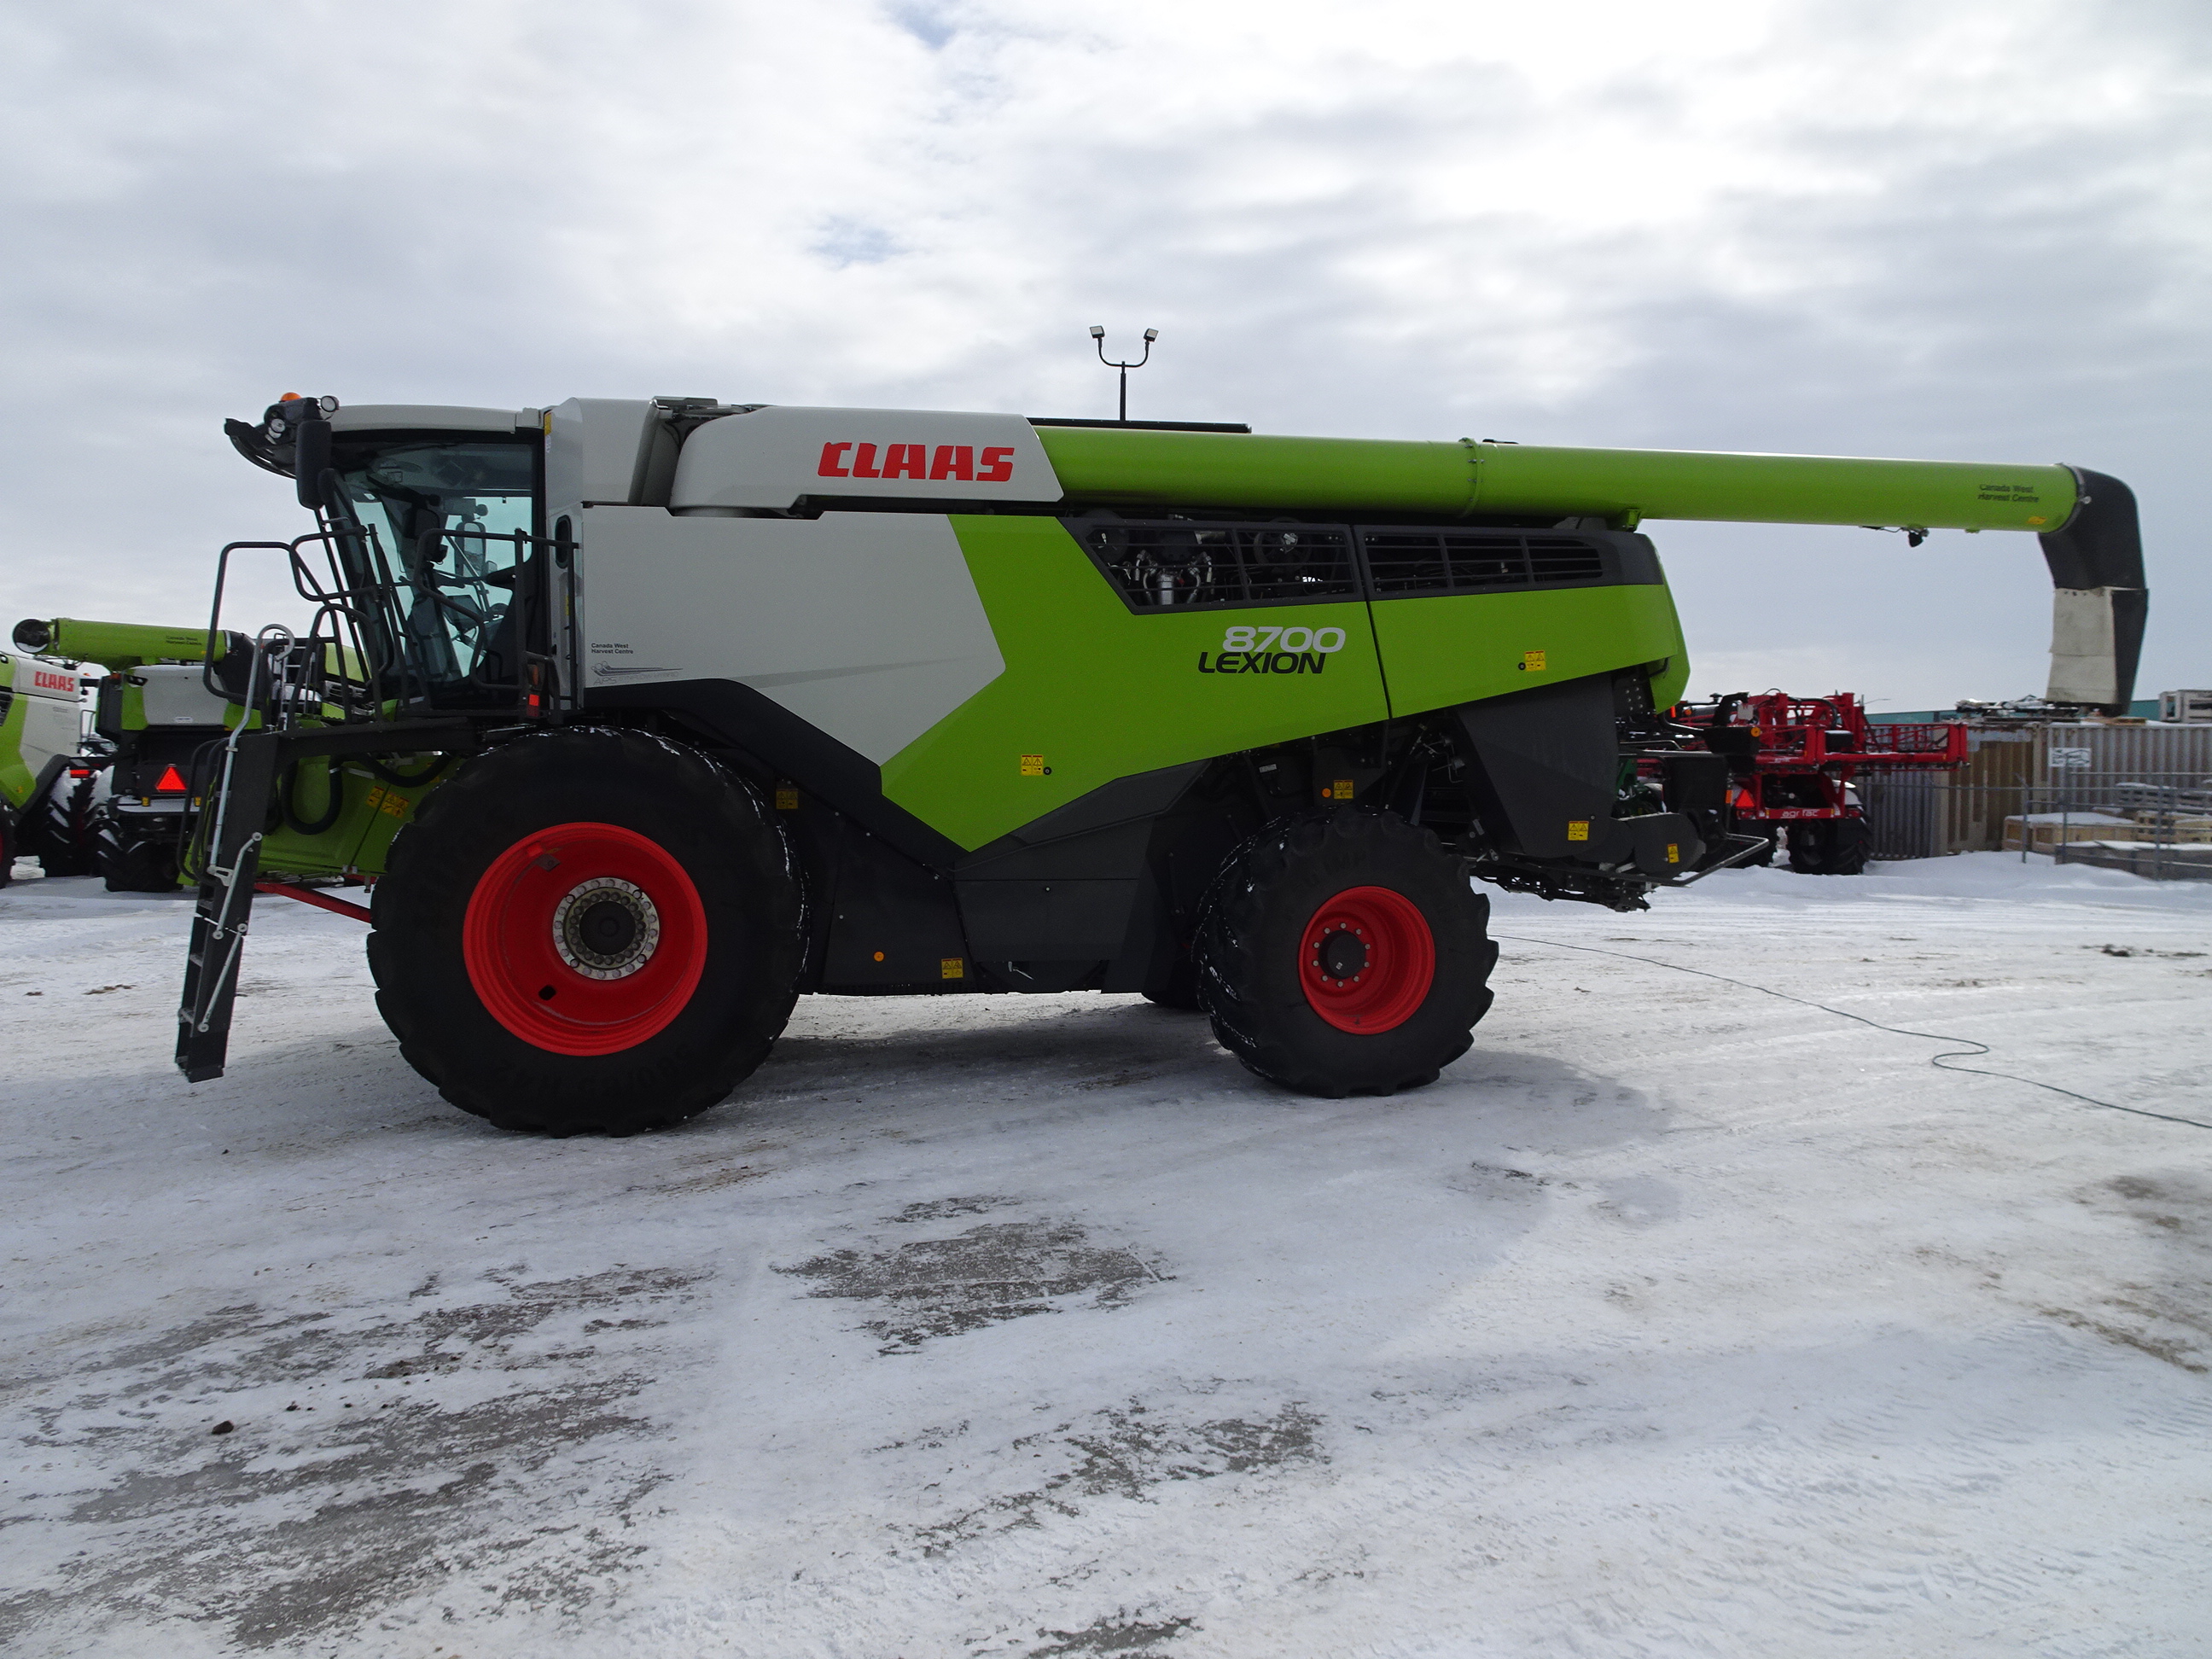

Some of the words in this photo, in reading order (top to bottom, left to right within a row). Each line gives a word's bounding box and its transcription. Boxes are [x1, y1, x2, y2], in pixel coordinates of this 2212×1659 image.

[817, 441, 1015, 481] CLAAS
[1222, 626, 1347, 653] 8700
[1197, 651, 1327, 674] LEXION
[34, 671, 75, 692] CLAAS
